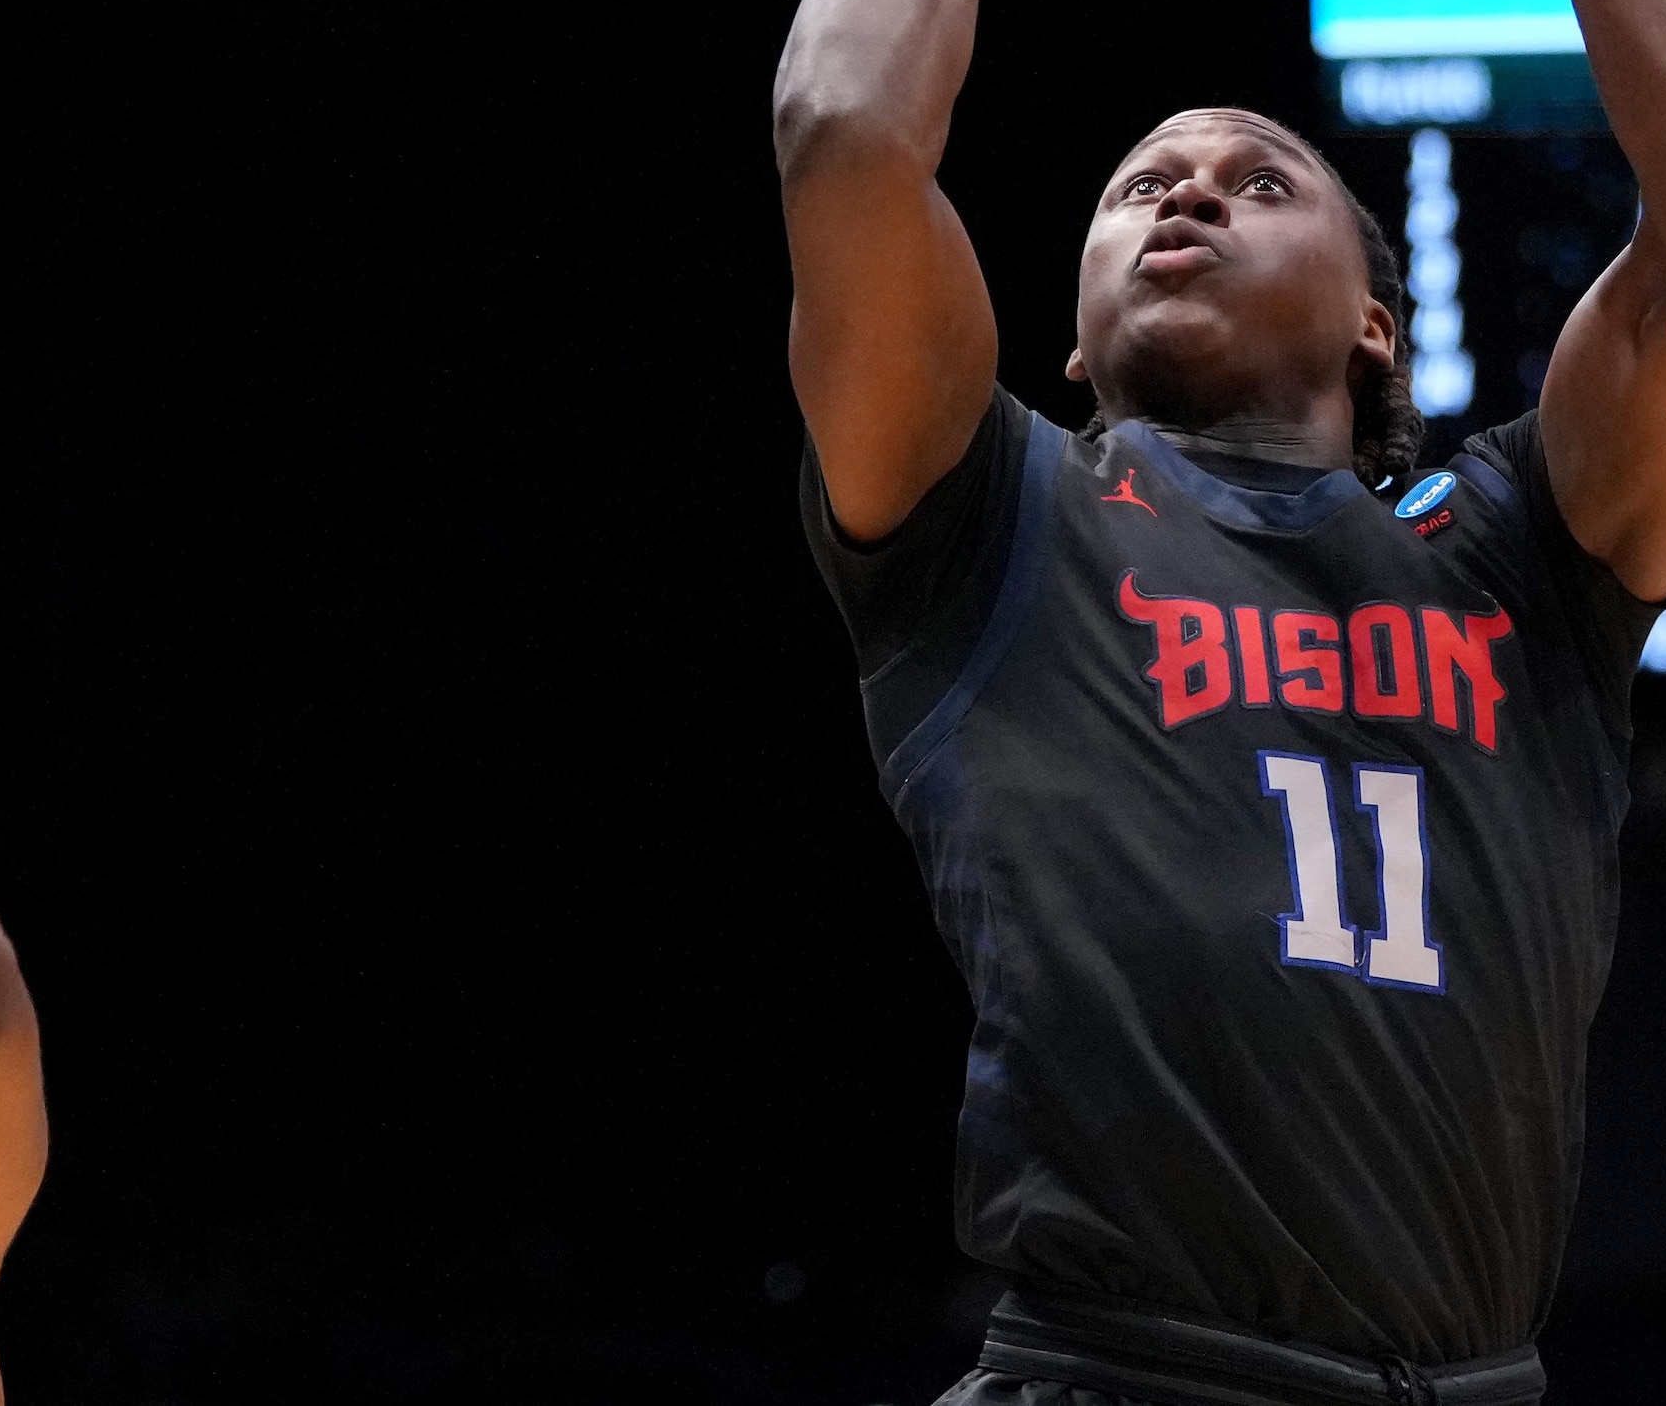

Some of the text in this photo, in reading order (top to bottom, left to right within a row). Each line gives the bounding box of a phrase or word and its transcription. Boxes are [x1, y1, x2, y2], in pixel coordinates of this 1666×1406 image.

[1406, 476, 1453, 514] NCAA
[1119, 570, 1514, 754] BISON
[1257, 750, 1445, 995] 11
